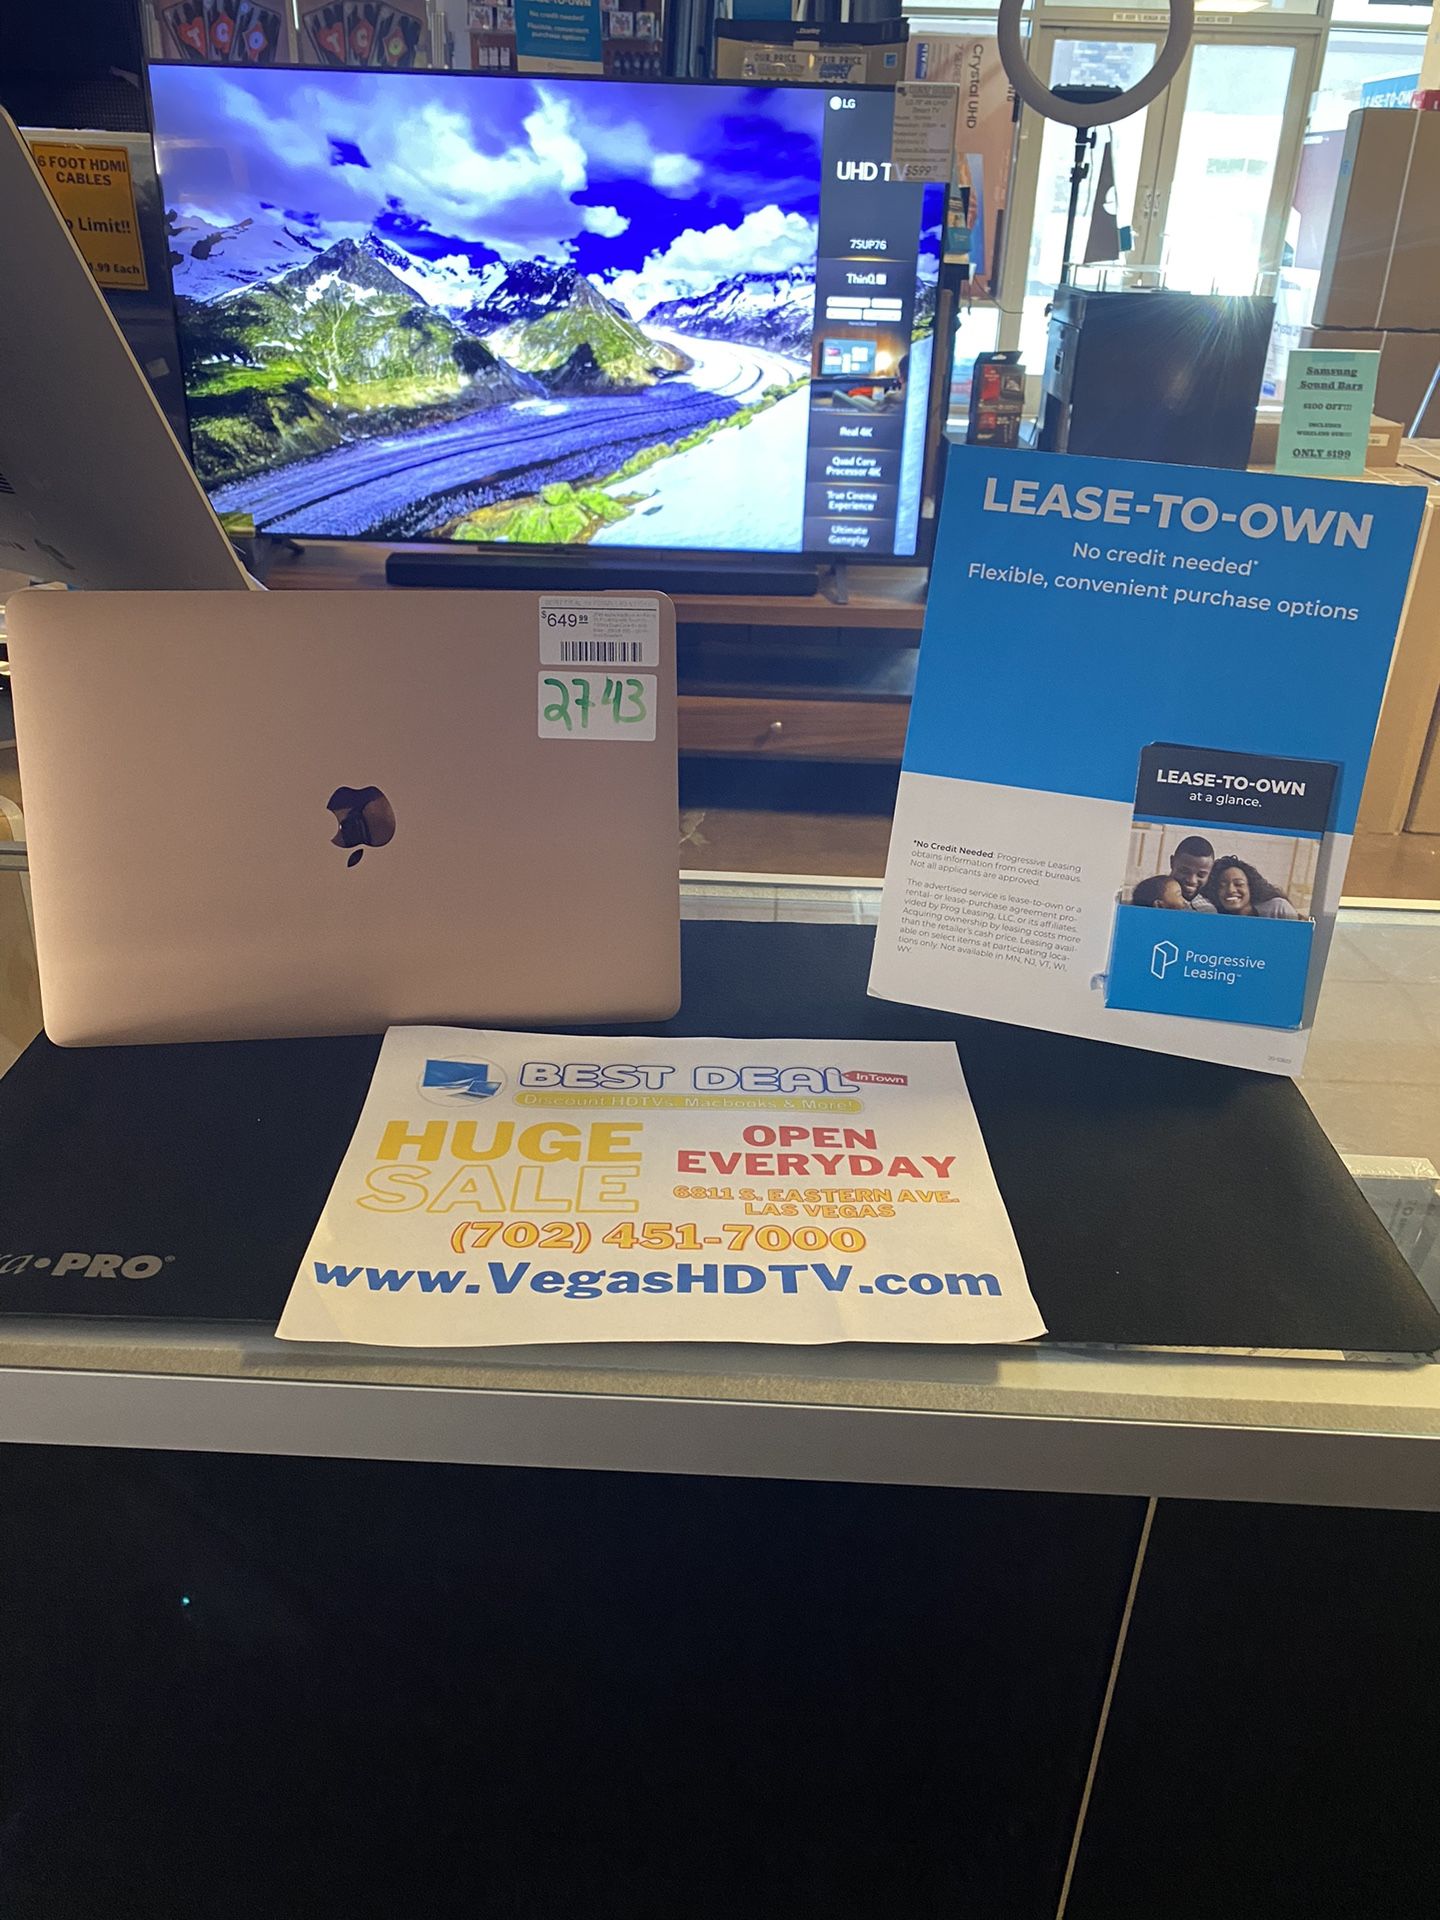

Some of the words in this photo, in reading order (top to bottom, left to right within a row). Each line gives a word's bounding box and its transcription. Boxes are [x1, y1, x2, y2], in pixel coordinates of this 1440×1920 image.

[966, 44, 984, 98] Crystal
[842, 98, 856, 109] LG
[966, 101, 978, 128] UHD
[37, 155, 46, 167] 6
[49, 156, 86, 170] FOOT
[90, 158, 126, 172] HDMI
[836, 160, 879, 181] UHD
[56, 171, 112, 185] CABLES
[78, 217, 131, 233] Limit!!
[113, 263, 140, 274] Each
[1306, 367, 1358, 377] Samsung
[1299, 380, 1335, 391] Sound
[1338, 382, 1363, 391] Bars
[840, 427, 859, 437] Real
[860, 427, 873, 437] 4K
[832, 456, 855, 466] Quad
[856, 457, 876, 467] Core
[1292, 448, 1324, 459] ONLY
[1326, 450, 1351, 459] $199
[826, 466, 867, 476] Processor
[826, 491, 845, 500] True
[846, 491, 877, 501] Cinema
[828, 501, 875, 512] Experience
[983, 477, 1374, 549] LEASE-TO-OWN
[831, 525, 868, 535] Ultimate
[828, 535, 870, 547] Gameplay
[1073, 542, 1101, 559] No
[1106, 545, 1166, 567] credit
[968, 562, 1049, 588] Flexible,
[1054, 574, 1168, 600] convenient
[1174, 588, 1271, 612] purchase
[1277, 598, 1359, 621] options
[1156, 769, 1306, 796] LEASE-TO-OWN
[1189, 791, 1203, 802] at
[1216, 793, 1262, 808] glance.
[911, 848, 942, 860] obtains
[944, 854, 993, 868] information
[995, 862, 1016, 872] from
[1018, 865, 1042, 876] credit
[930, 842, 957, 853] Credit
[997, 852, 1045, 867] Progressive
[1048, 860, 1081, 874] Leasing
[910, 858, 925, 867] Not
[926, 861, 936, 869] all
[938, 862, 981, 877] applicants
[982, 871, 996, 879] are
[907, 877, 922, 887] The
[924, 880, 967, 894] advertised
[969, 887, 999, 899] service
[904, 897, 926, 907] vided
[928, 901, 939, 911] by
[940, 903, 960, 914] Prog
[1009, 904, 1056, 919] agreement
[901, 916, 920, 926] than
[922, 920, 936, 929] the
[974, 928, 993, 938] cash
[1020, 936, 1052, 949] Leasing
[903, 907, 942, 921] Acquiring
[944, 913, 988, 929] ownership
[990, 921, 1000, 931] by
[1001, 922, 1032, 936] leasing
[1033, 927, 1056, 938] costs
[1058, 933, 1081, 942] more
[899, 935, 918, 945] tions
[941, 942, 955, 951] Not
[957, 945, 993, 958] available
[900, 926, 917, 935] able
[931, 931, 955, 942] select
[957, 935, 980, 946] items
[992, 941, 1047, 959] participating
[1185, 950, 1266, 970] Progressive
[519, 1062, 675, 1090] BEST
[693, 1065, 860, 1094] DEAL
[856, 1071, 905, 1085] InTown
[523, 1093, 605, 1107] Discount
[684, 1097, 777, 1110] Macbooks
[783, 1099, 795, 1110] &
[801, 1100, 855, 1113] More!
[376, 1120, 644, 1162] HUGE
[742, 1124, 878, 1150] OPEN
[677, 1150, 956, 1178] EVERYDAY
[356, 1165, 640, 1213] SALE
[672, 1185, 735, 1200] 6811
[738, 1188, 764, 1201] S.
[767, 1188, 892, 1203] EASTERN
[898, 1188, 960, 1203] AVE.
[745, 1203, 798, 1217] LAS
[802, 1204, 896, 1219] VEGAS
[451, 1221, 591, 1255] (702)
[601, 1221, 866, 1254] 451-7000
[313, 1261, 1003, 1299] www.VegasHDTV.com
